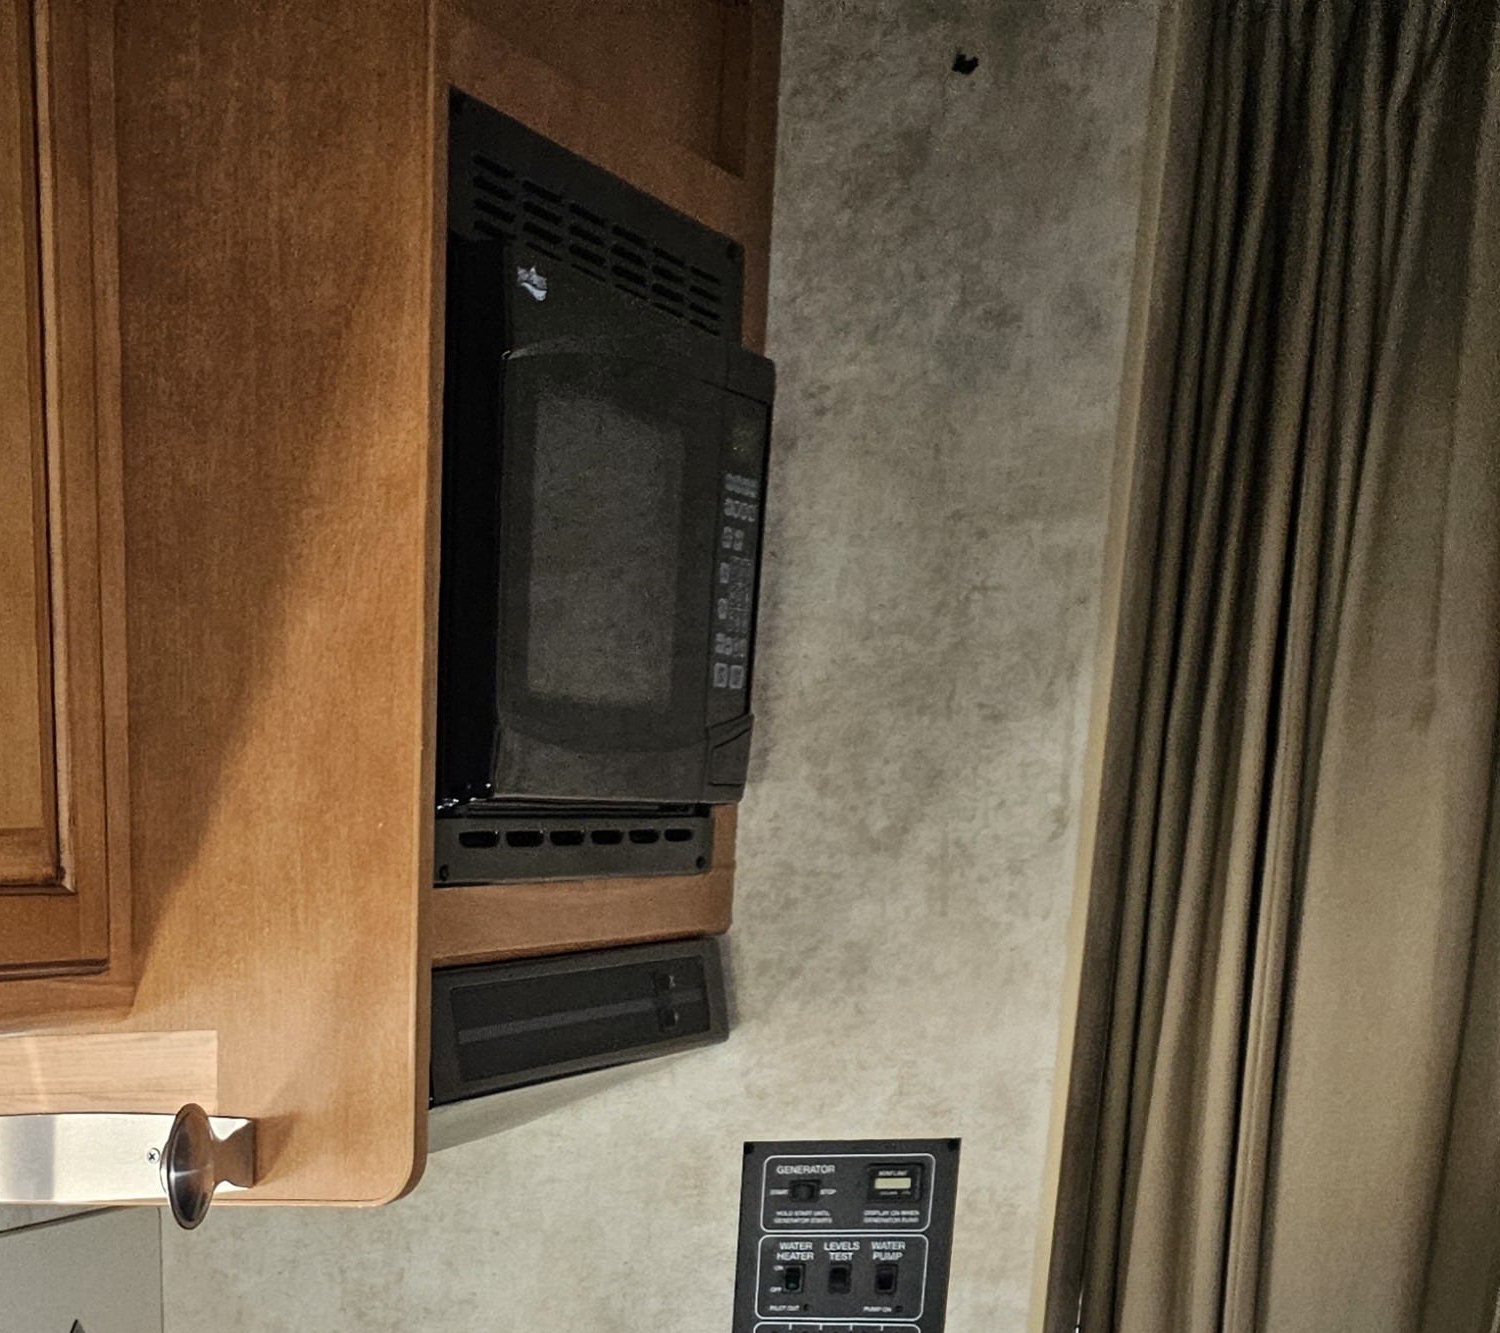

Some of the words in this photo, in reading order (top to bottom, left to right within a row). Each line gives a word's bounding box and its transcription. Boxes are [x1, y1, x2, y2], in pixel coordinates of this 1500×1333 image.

[776, 1165, 836, 1175] GENERATOR
[779, 1242, 813, 1250] WATER
[823, 1242, 860, 1250] LEVELS
[871, 1241, 906, 1250] WATER
[776, 1252, 814, 1260] HEATER
[829, 1252, 853, 1260] TEST
[872, 1252, 903, 1260] PUMP
